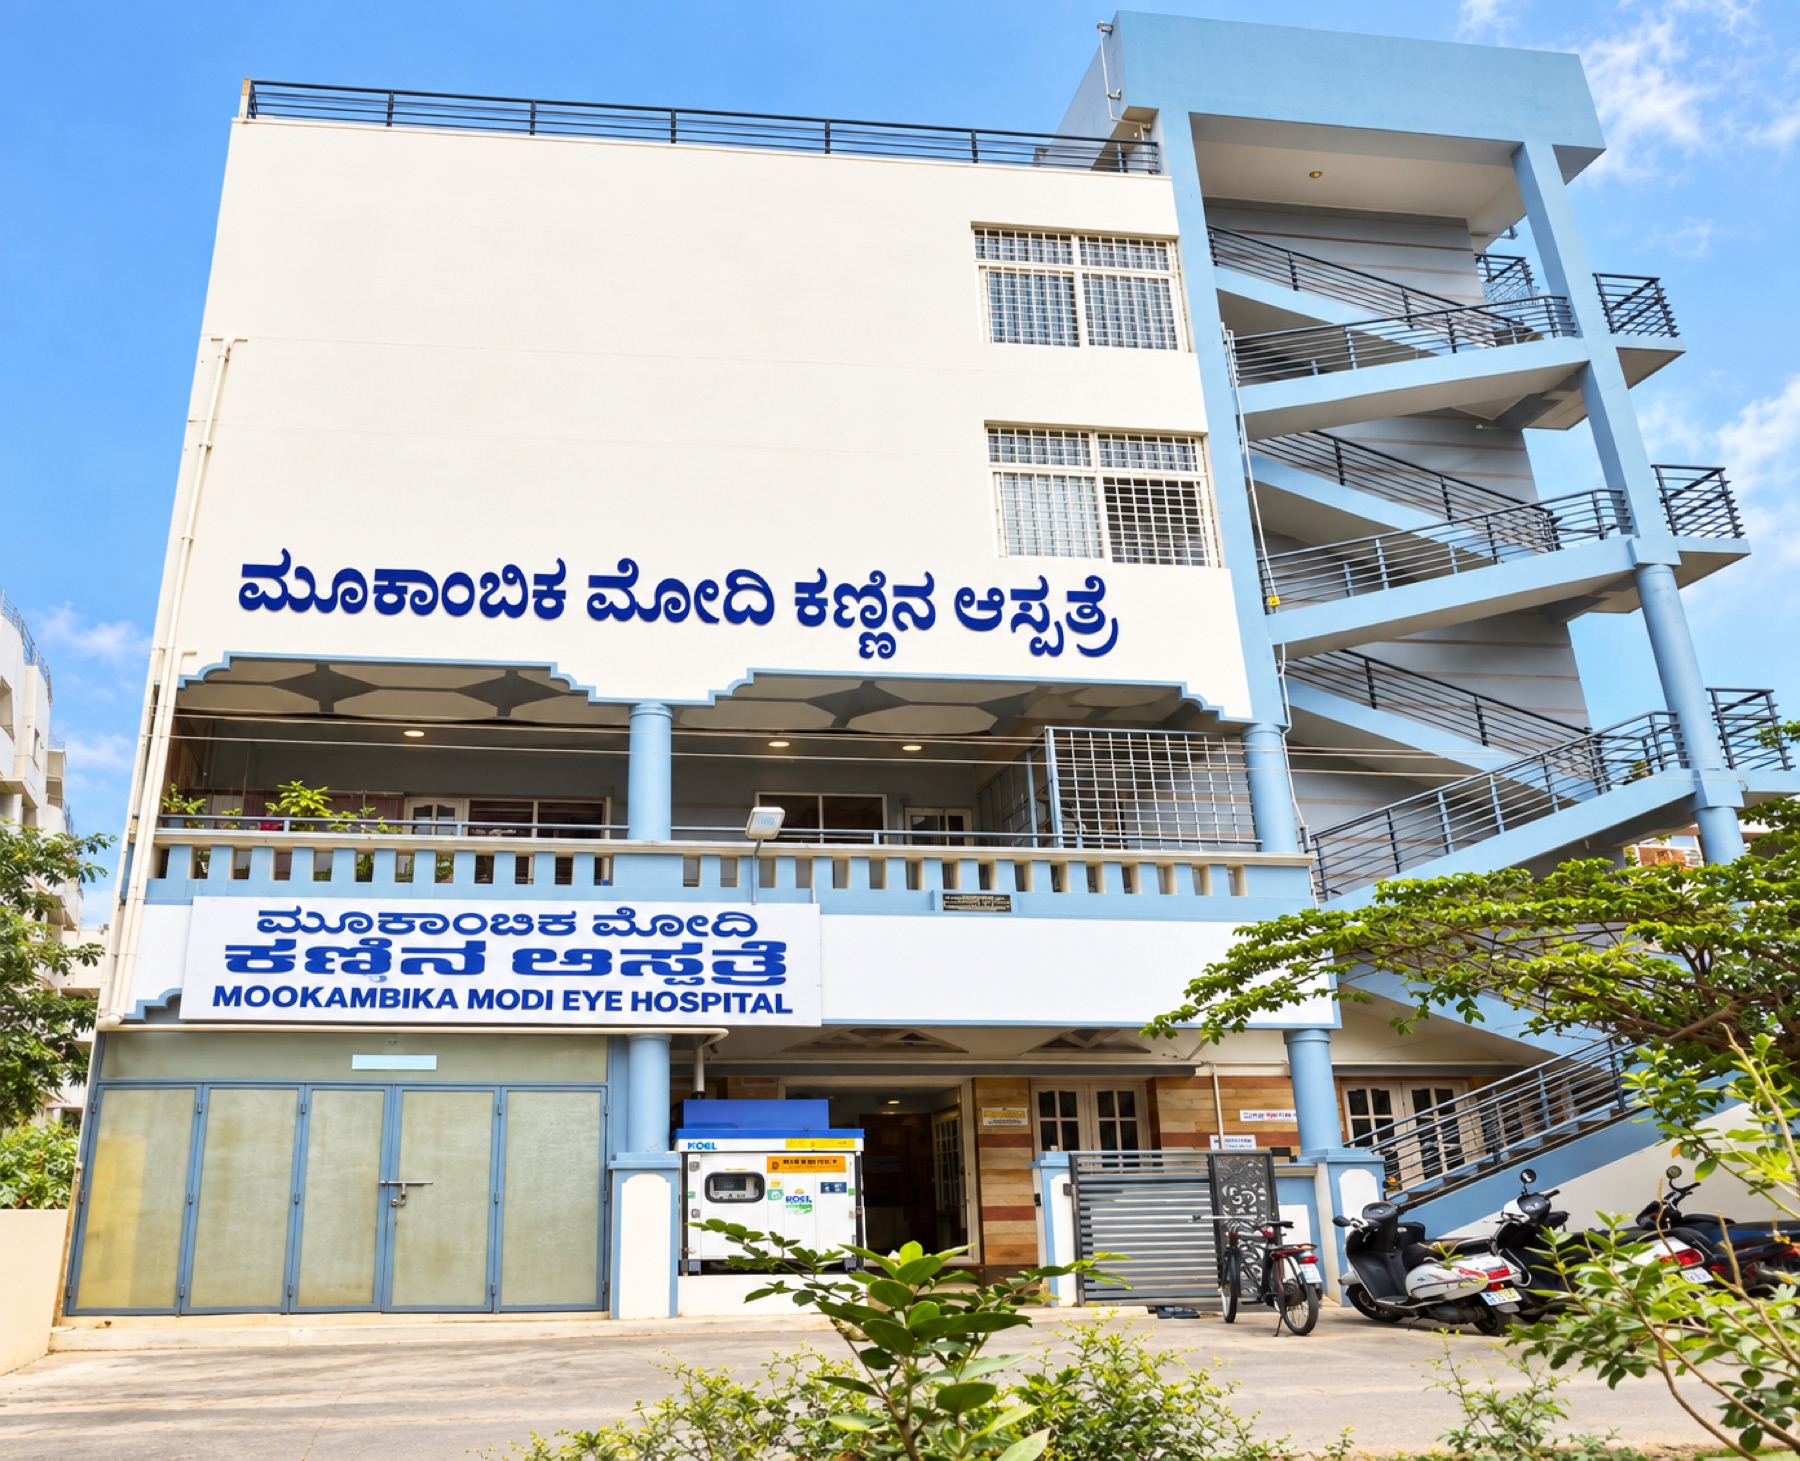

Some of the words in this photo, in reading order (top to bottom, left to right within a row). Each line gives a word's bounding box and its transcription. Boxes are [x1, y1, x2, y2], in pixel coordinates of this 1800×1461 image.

[238, 548, 567, 620] ಮೂಕಾಂಬಿಕ
[586, 557, 776, 626] ಮೋದಿ
[954, 574, 1119, 657] ಆಸ್ಪತ್ರೆ
[256, 905, 578, 937] ಮೂಕಾಂಬಿಕ
[592, 906, 759, 938] ಮೋದಿ
[212, 985, 459, 1010] MOOKAMBIKA
[467, 988, 554, 1012] MODI
[562, 989, 623, 1012] EYE
[630, 991, 793, 1015] HOSPITAL
